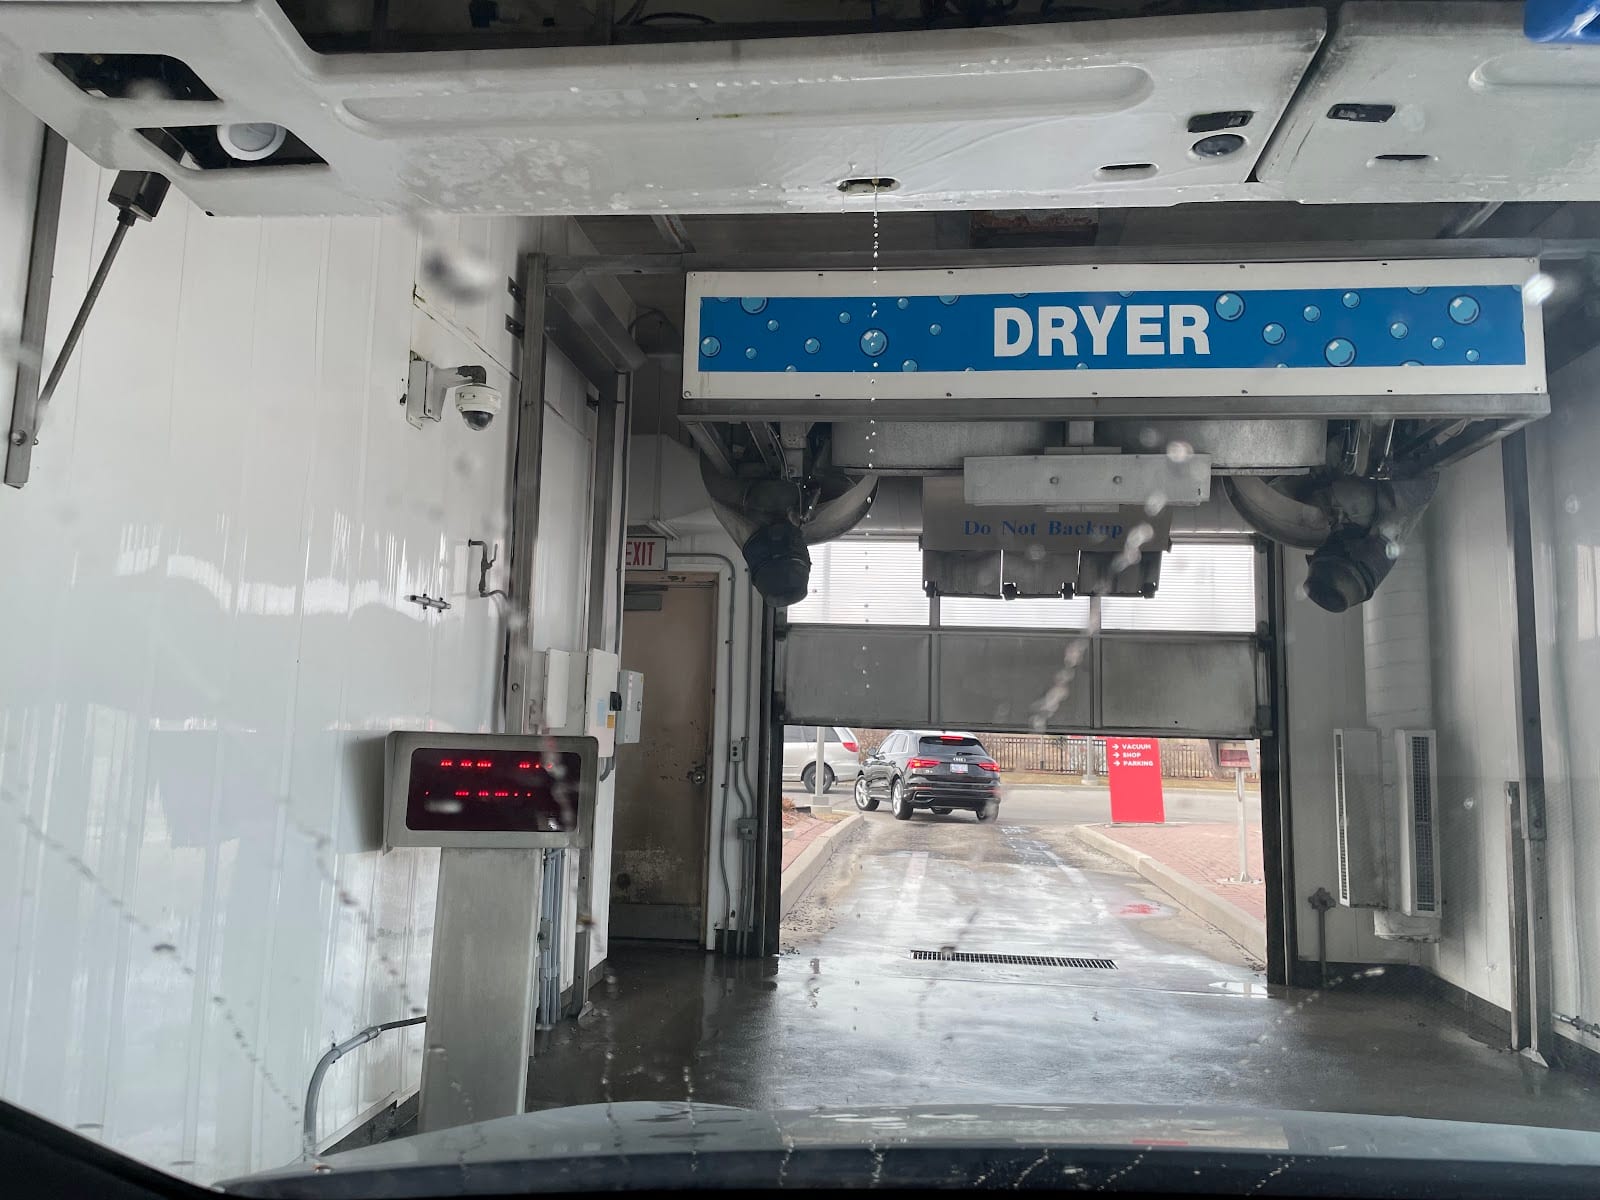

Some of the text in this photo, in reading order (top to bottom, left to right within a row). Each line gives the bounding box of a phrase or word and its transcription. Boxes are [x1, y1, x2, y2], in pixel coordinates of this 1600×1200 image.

[993, 304, 1211, 358] DRYER
[964, 520, 1123, 538] Do Not Backup
[625, 541, 655, 566] EXIT
